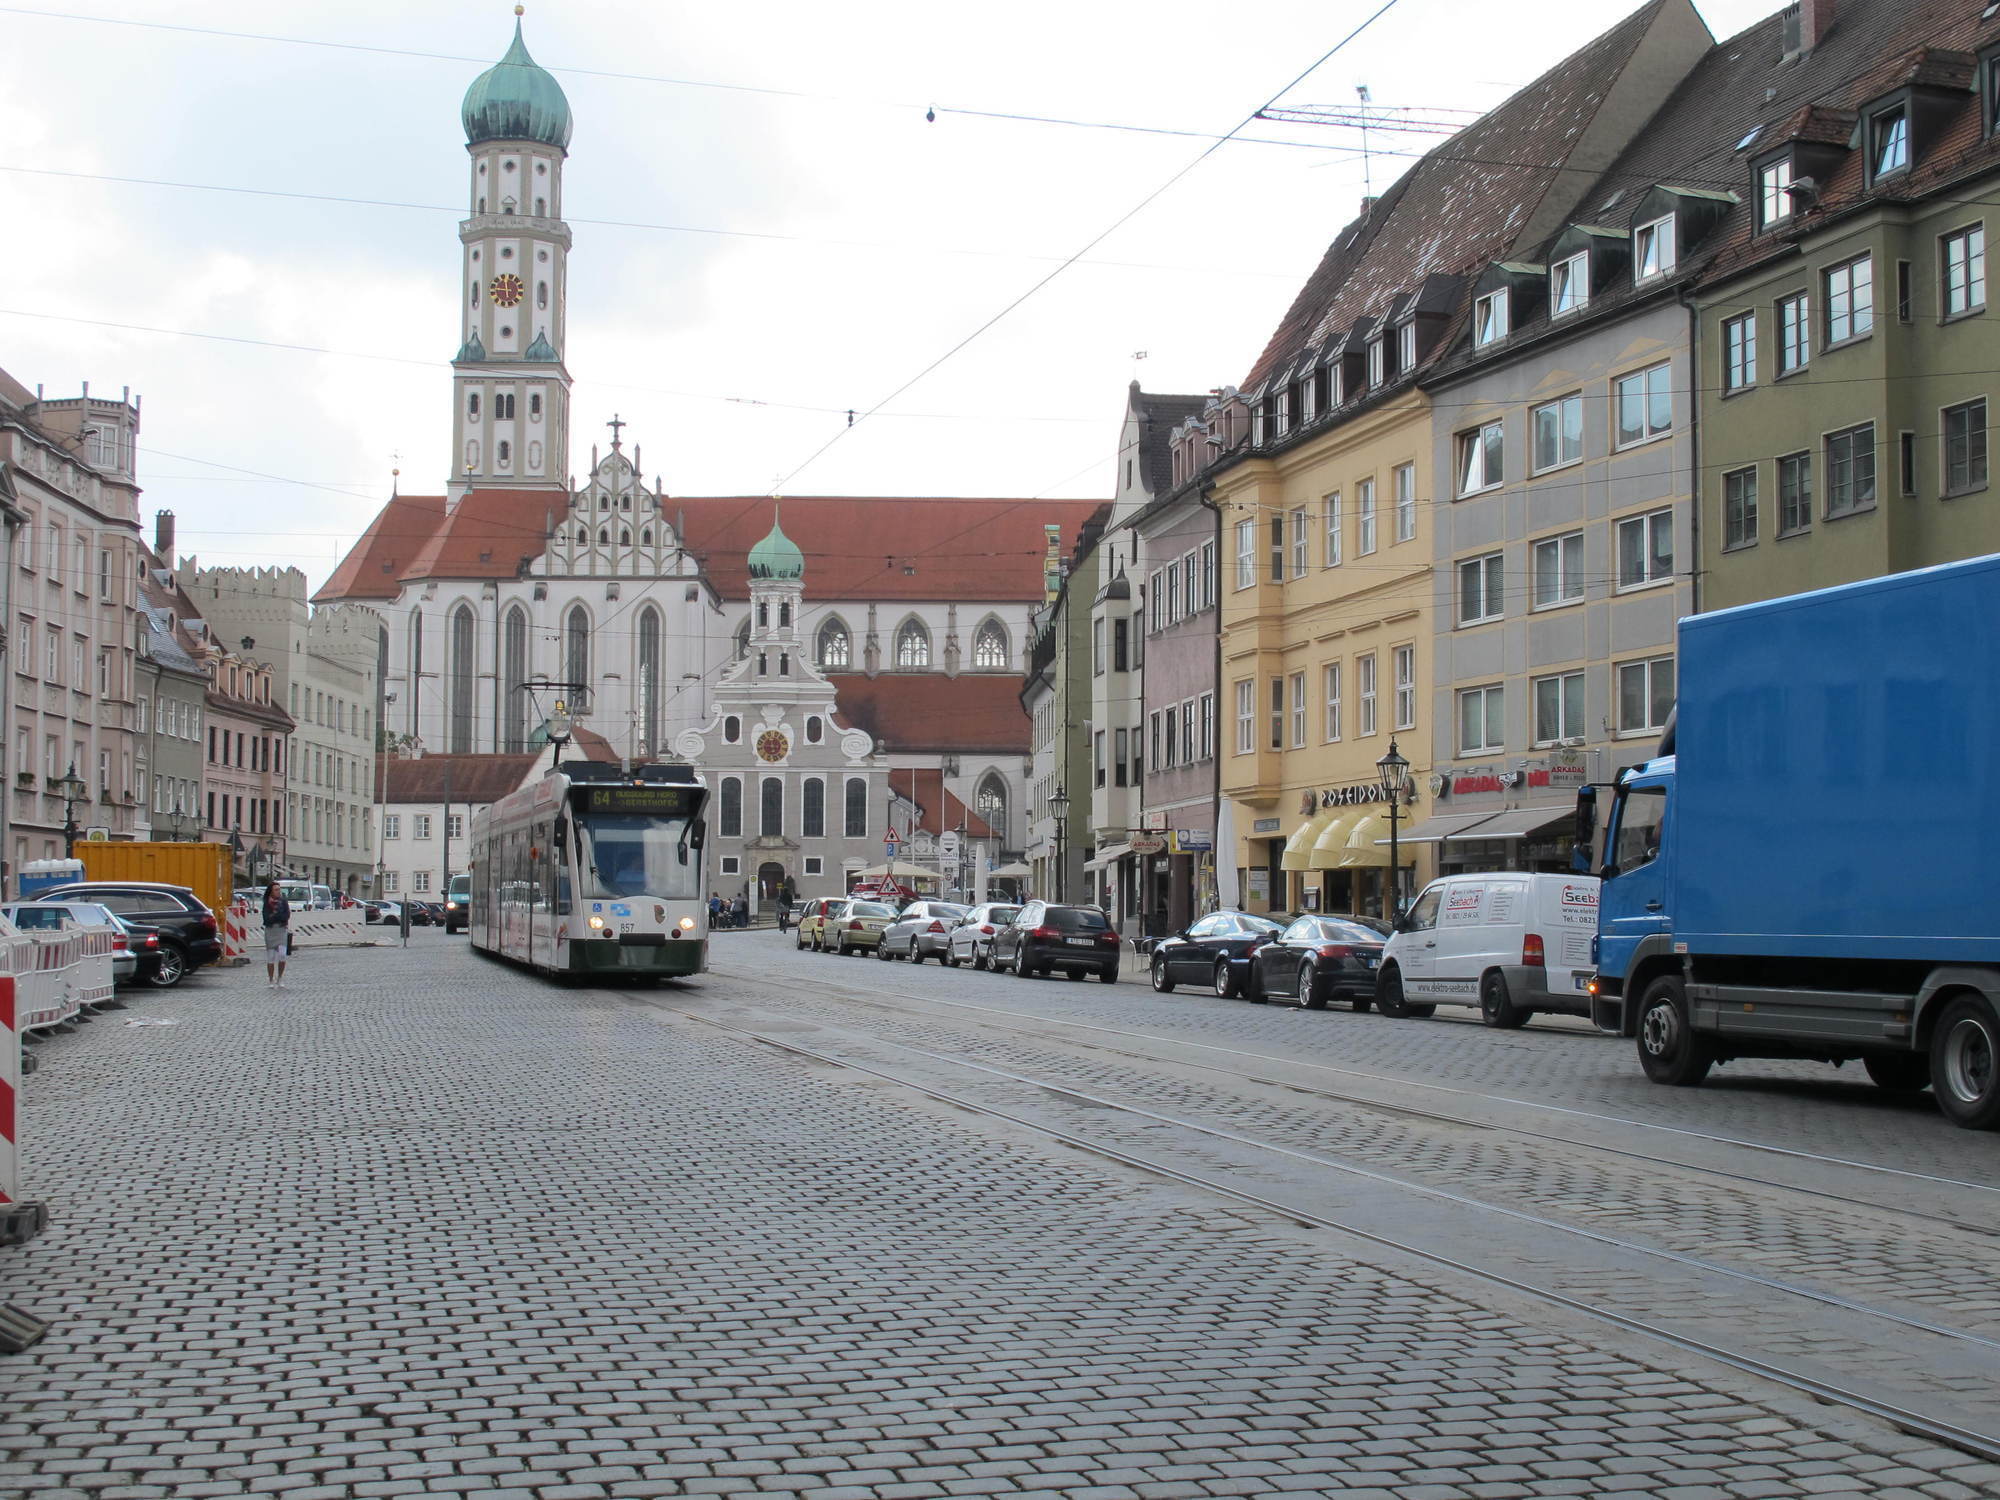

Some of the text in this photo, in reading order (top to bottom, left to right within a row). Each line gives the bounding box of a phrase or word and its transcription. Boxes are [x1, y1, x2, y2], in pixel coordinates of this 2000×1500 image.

[594, 791, 611, 806] 64
[1321, 783, 1386, 806] POSEIDON
[1579, 916, 1596, 924] 0821
